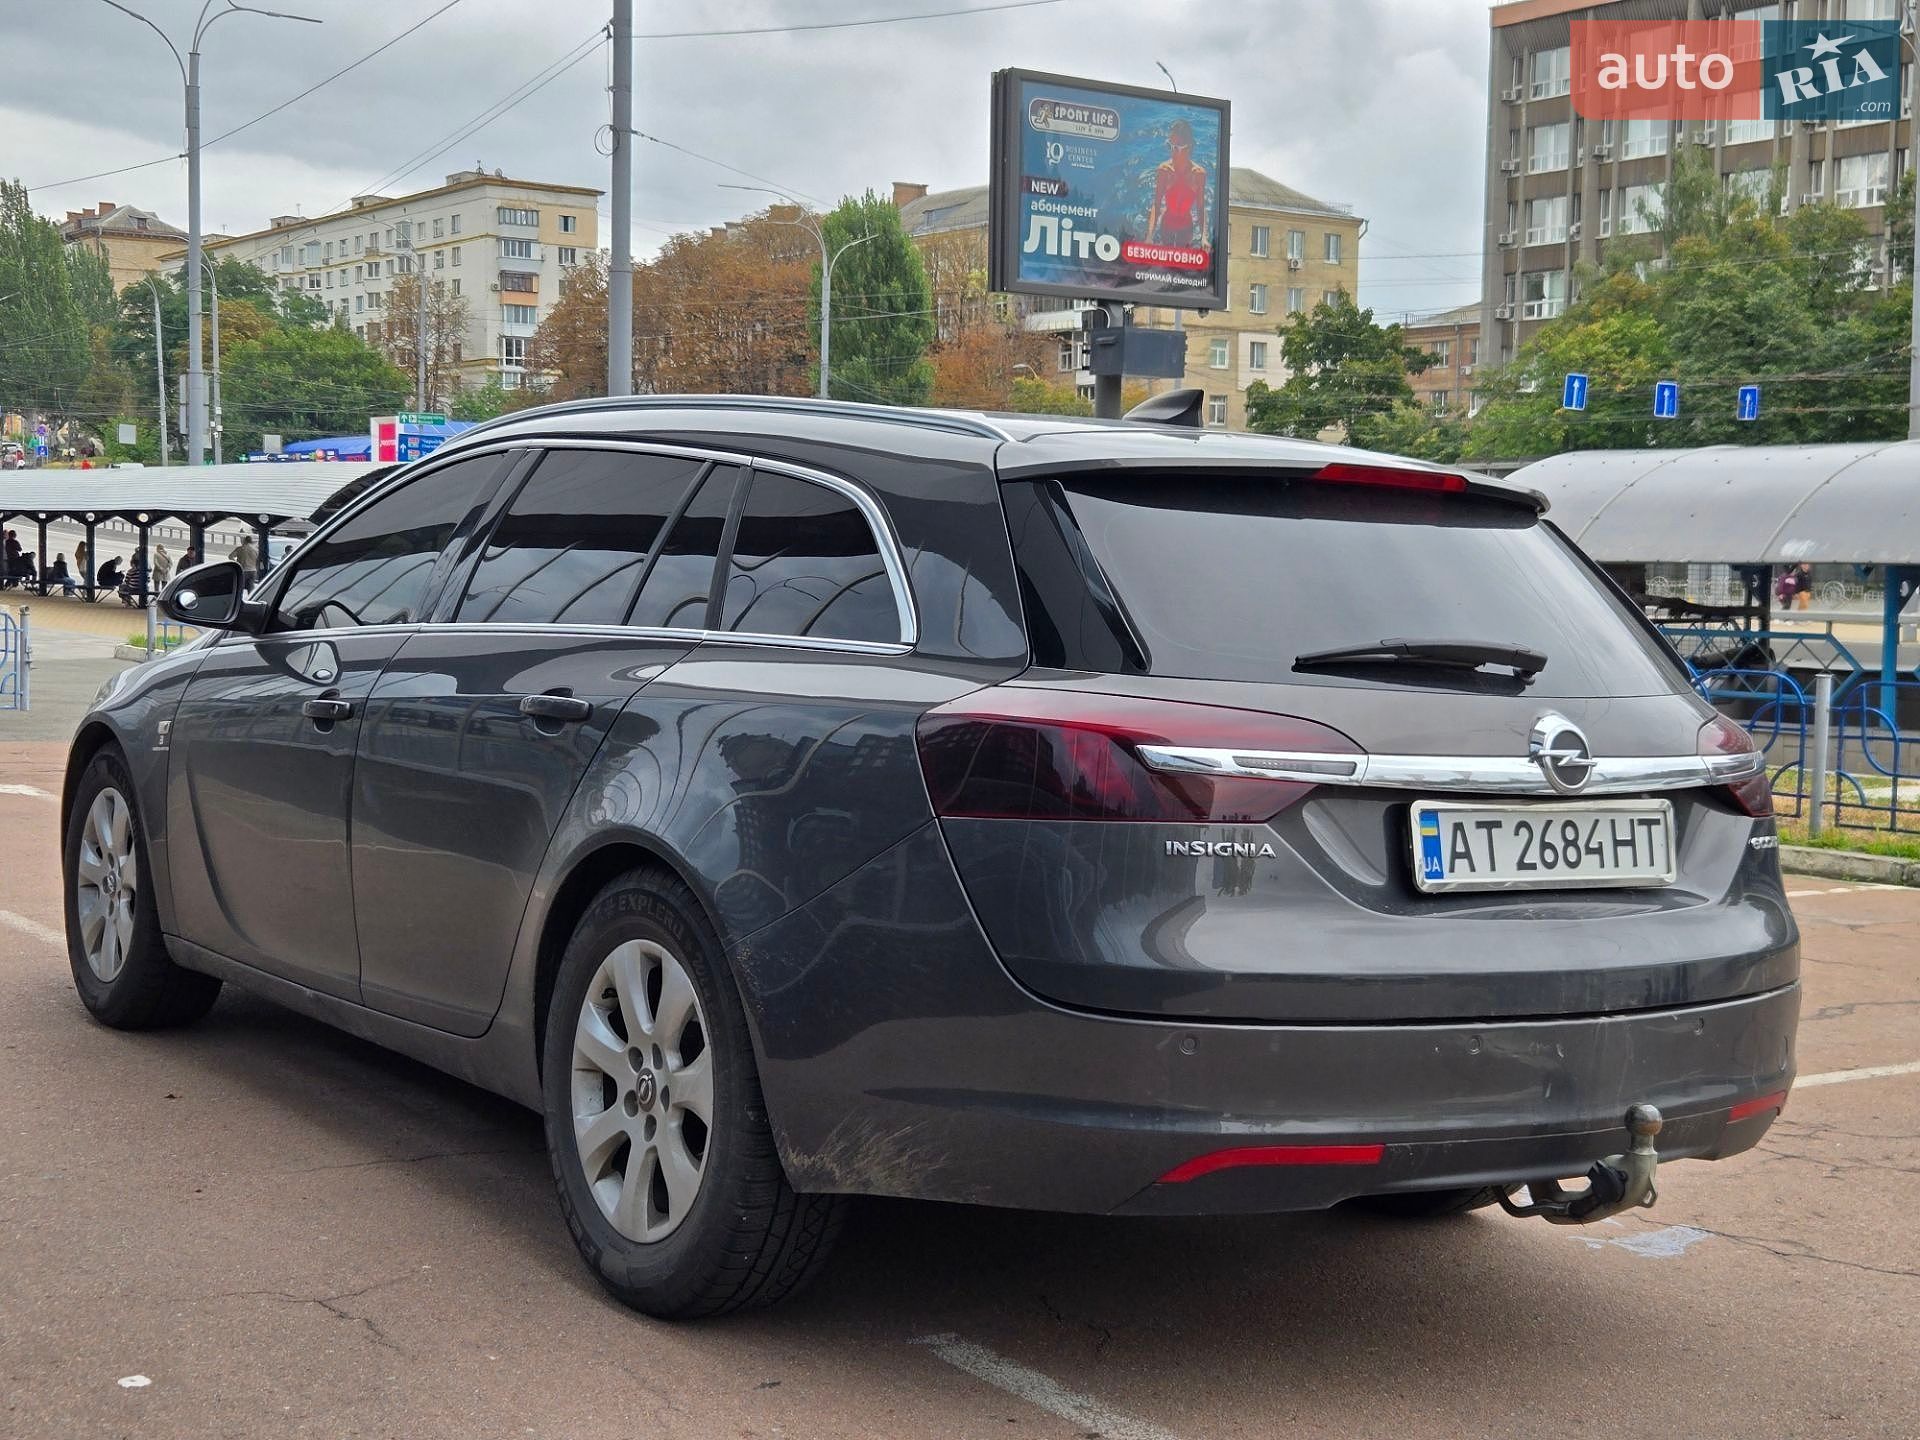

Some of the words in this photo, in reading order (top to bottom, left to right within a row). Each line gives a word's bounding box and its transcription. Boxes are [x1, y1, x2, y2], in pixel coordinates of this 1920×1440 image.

[1054, 106, 1089, 122] SPORT
[1092, 111, 1113, 126] LIFE
[1031, 181, 1059, 195] NEW
[1030, 199, 1098, 218] абонемент
[1023, 215, 1121, 262] Літо
[1127, 246, 1203, 265] БЕЗКОШТОВНО
[1165, 840, 1277, 858] INSIGNIA
[1424, 856, 1441, 873] UA
